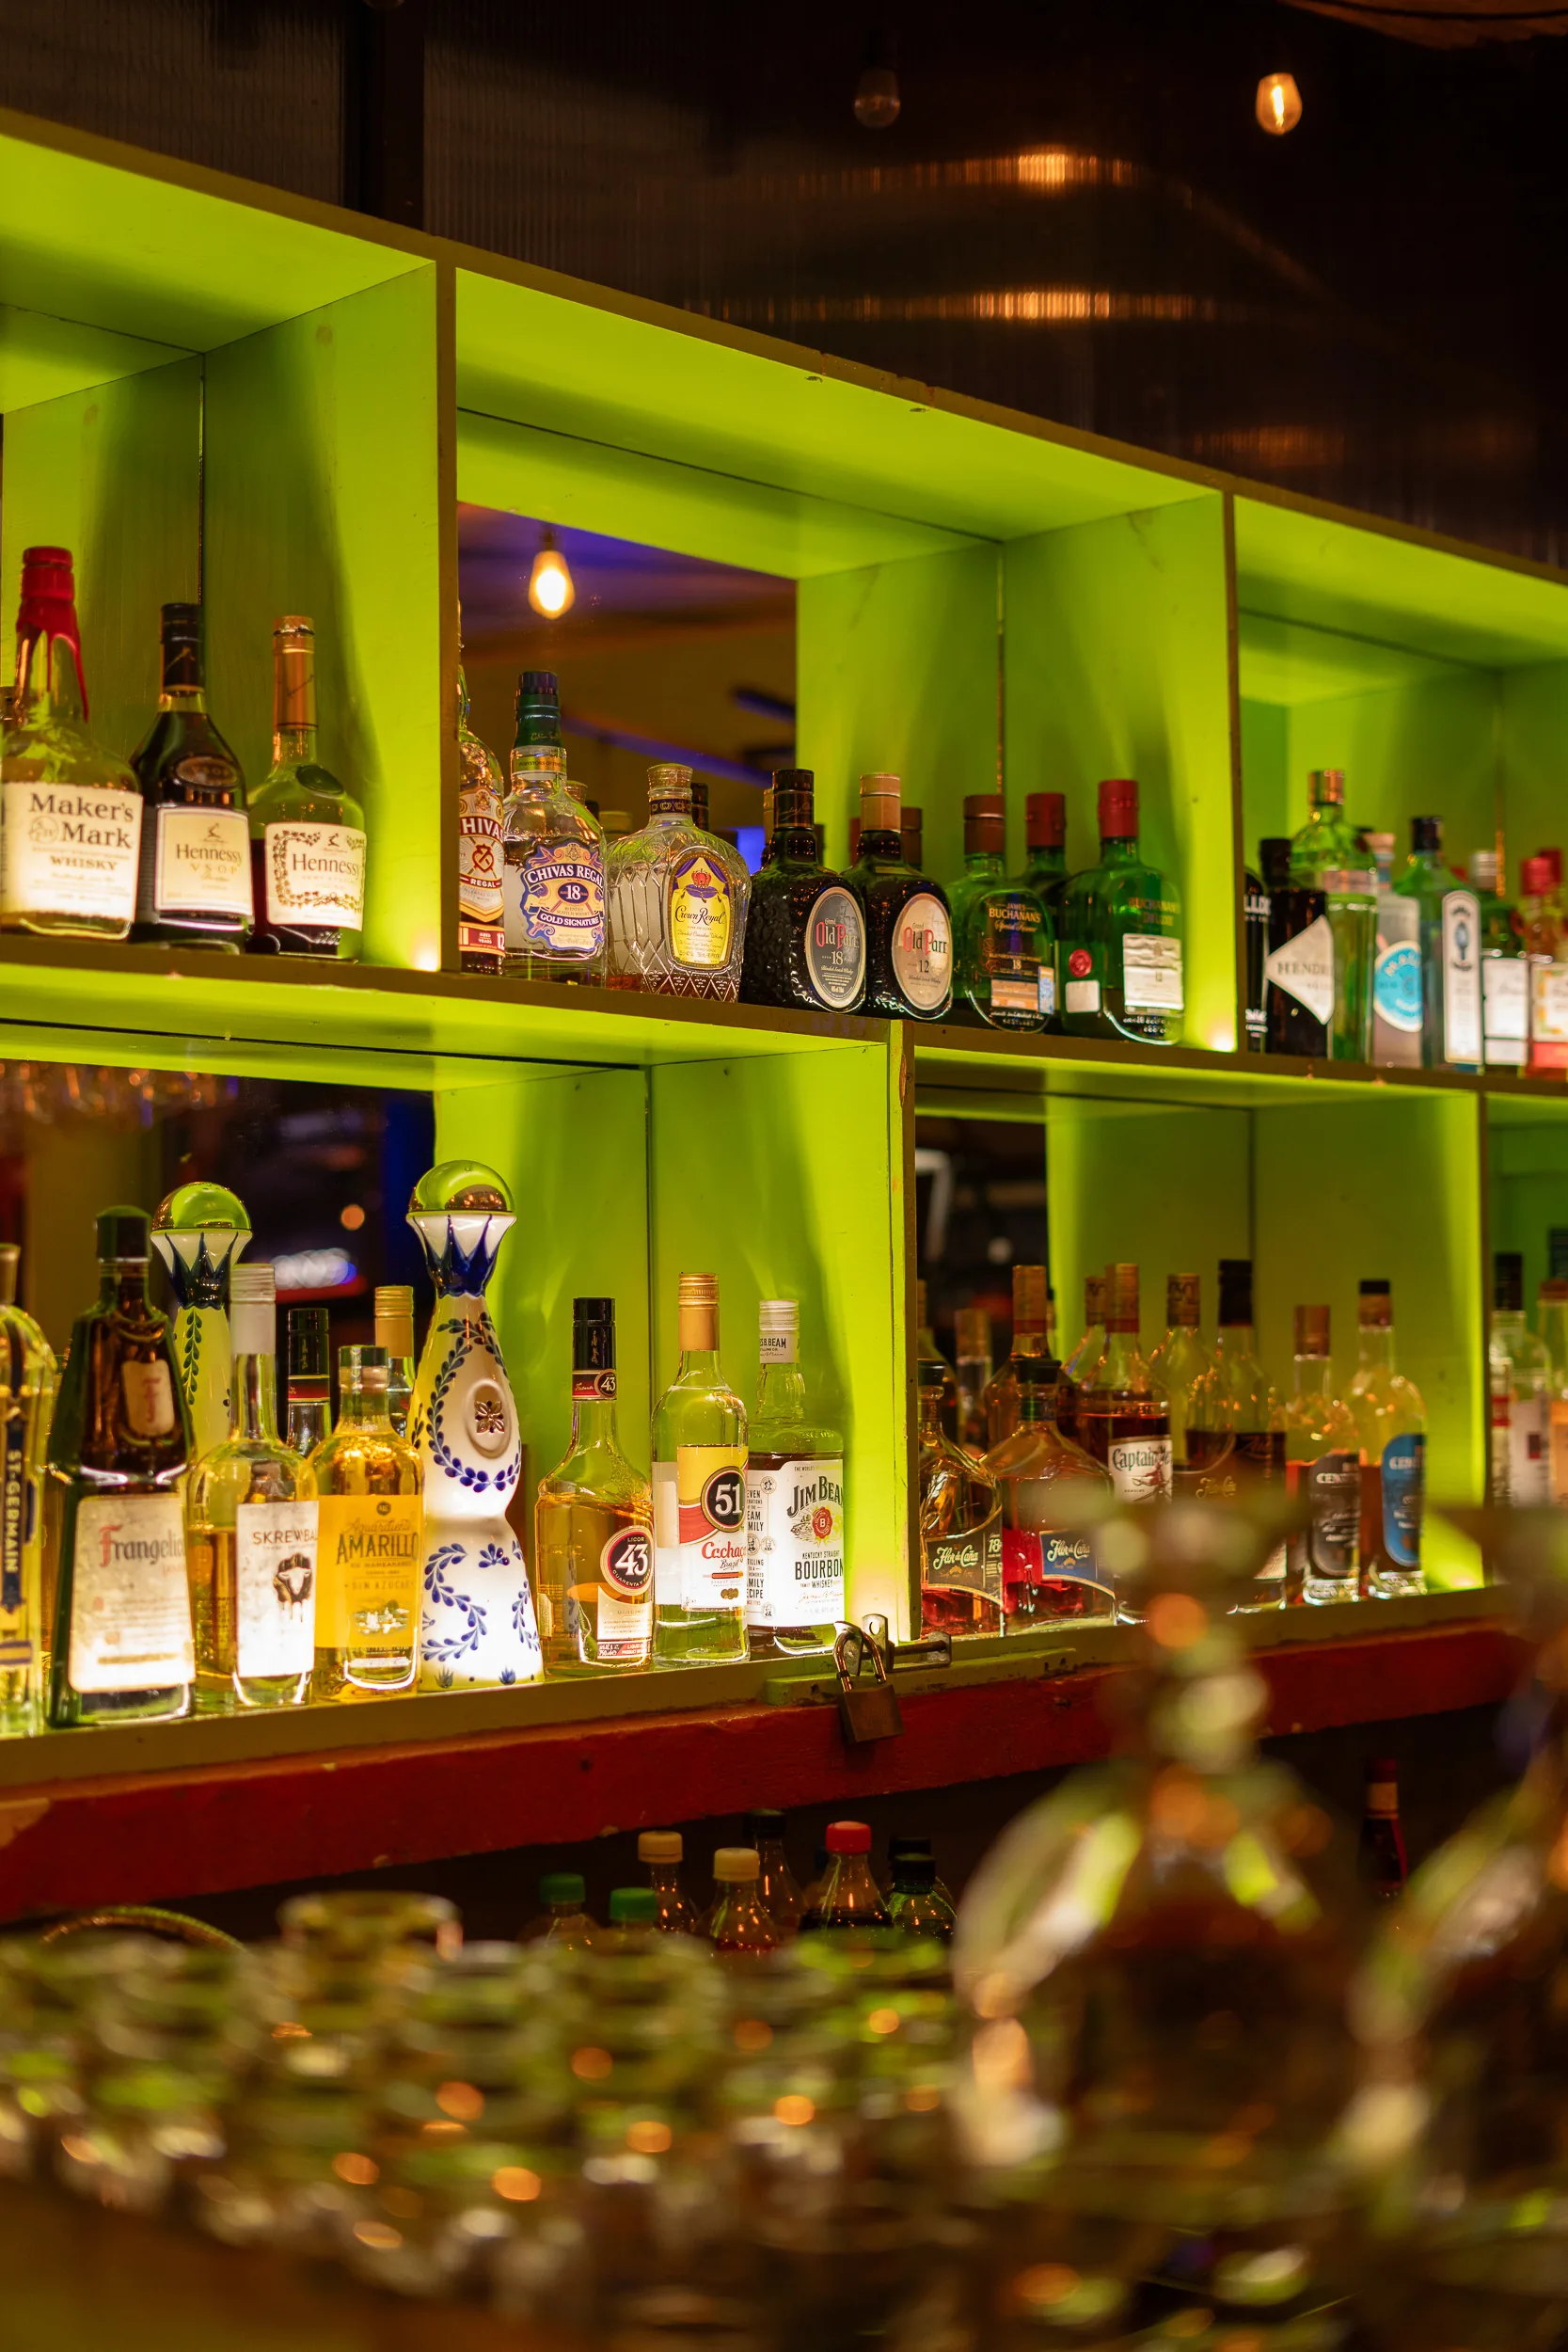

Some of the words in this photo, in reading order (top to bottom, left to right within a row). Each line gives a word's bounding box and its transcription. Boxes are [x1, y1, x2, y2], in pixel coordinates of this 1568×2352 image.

[29, 792, 134, 823] Maker's
[61, 821, 131, 849] Mark
[50, 855, 117, 871] WHISKY
[176, 843, 242, 866] Hennessy
[292, 853, 360, 881] Hennessy
[470, 878, 497, 888] REGAL
[527, 865, 574, 883] CHIVAS
[576, 865, 603, 888] REGAL
[565, 885, 581, 900] 18
[540, 913, 563, 926] GOLD
[564, 916, 599, 927] SIGNATURE
[674, 904, 699, 923] Crown
[692, 907, 726, 927] Royal
[497, 932, 505, 951] 12
[816, 922, 836, 947] Old
[835, 923, 860, 950] Parr
[903, 927, 922, 952] Old
[924, 930, 947, 955] Parr
[832, 950, 844, 966] 18
[919, 960, 929, 973] 12
[1012, 960, 1022, 970] 18
[768, 1337, 787, 1349] BEAM
[600, 1376, 616, 1391] 43
[1112, 1448, 1158, 1471] Captain
[714, 1483, 743, 1516] 51
[747, 1489, 761, 1499] EVEN
[786, 1485, 817, 1518] JIM
[748, 1510, 761, 1520] EAM
[819, 1518, 826, 1527] B
[748, 1521, 764, 1532] MILY
[335, 1532, 420, 1565] AMARILLO
[989, 1538, 1002, 1553] 18
[614, 1543, 649, 1576] 43
[612, 1569, 640, 1587] CUARENTA
[795, 1558, 844, 1581] BOURBON
[811, 1579, 833, 1589] WHISKEY
[747, 1588, 764, 1599] ECIPE
